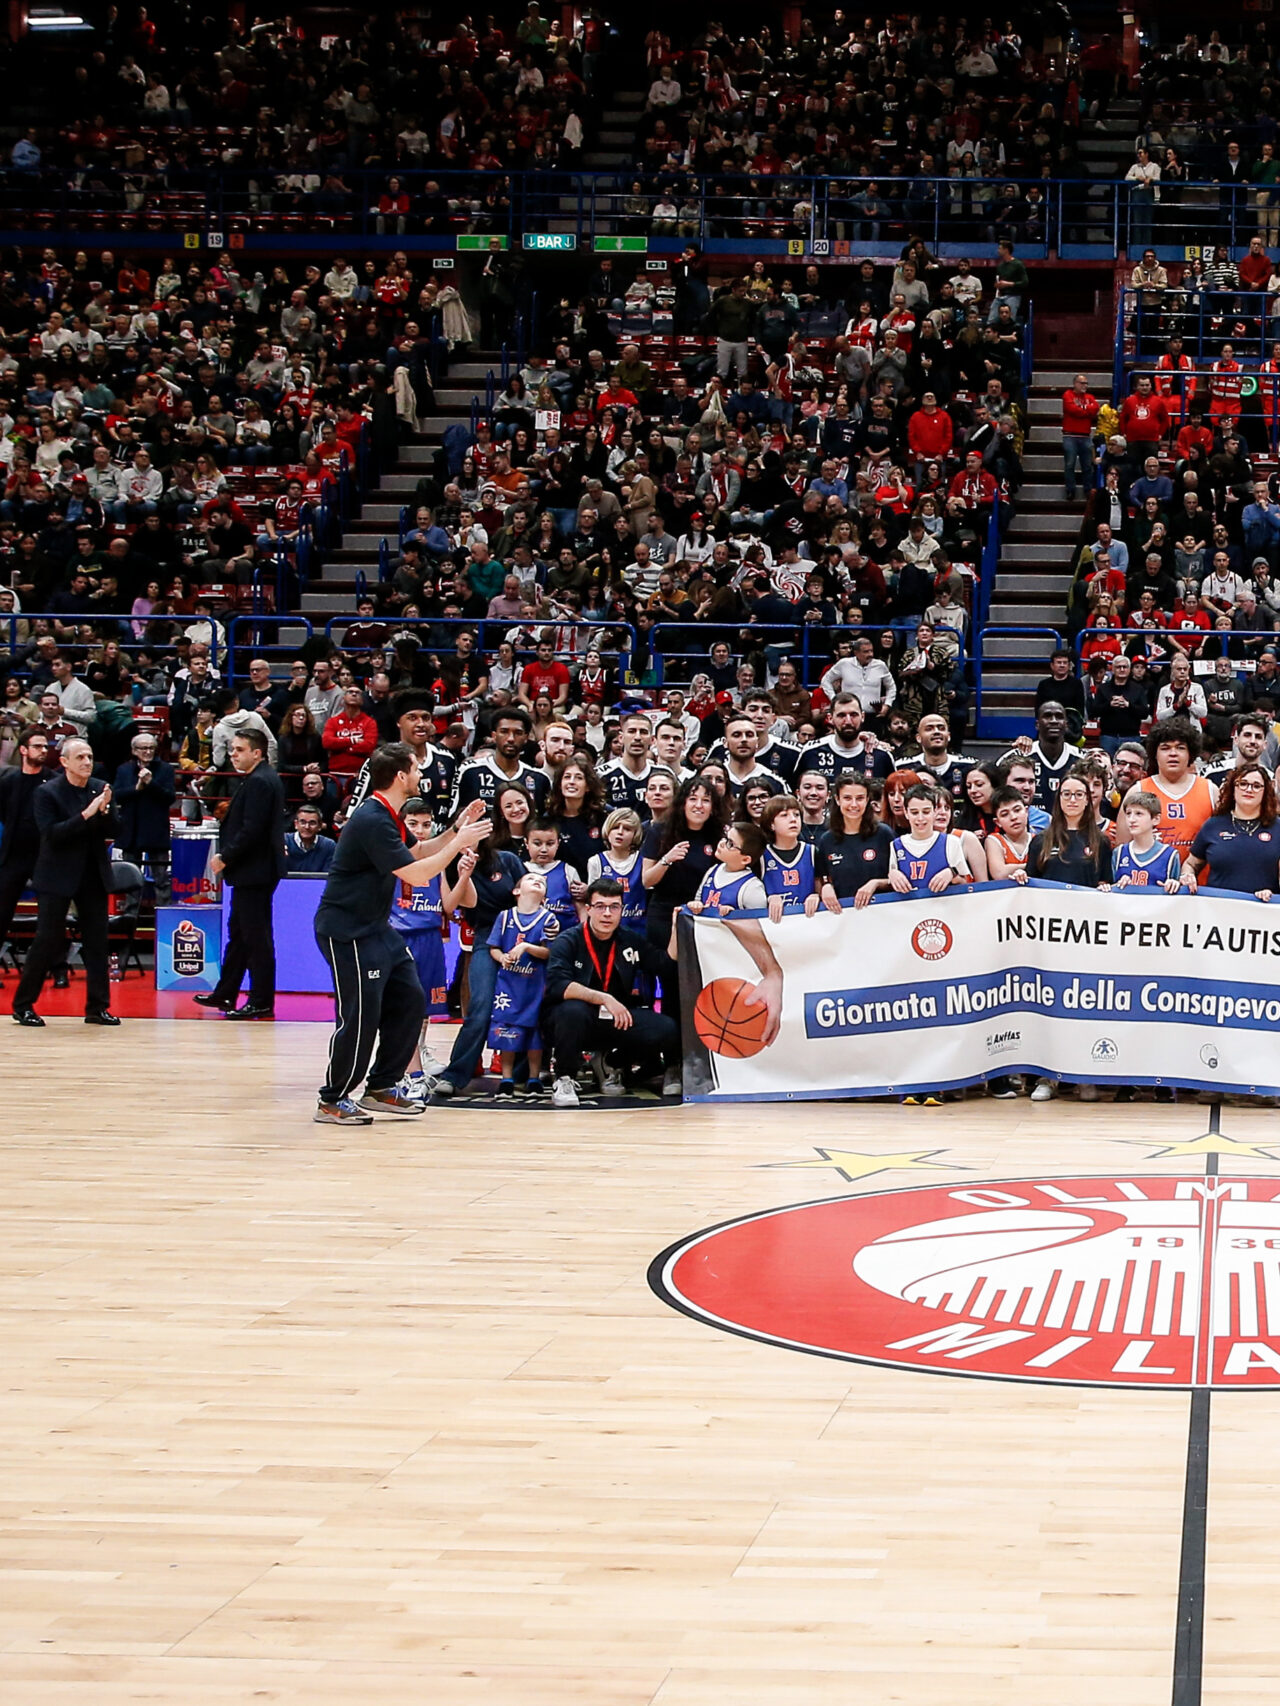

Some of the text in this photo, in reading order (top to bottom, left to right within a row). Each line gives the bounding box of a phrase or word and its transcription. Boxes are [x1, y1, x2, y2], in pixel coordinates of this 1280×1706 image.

[210, 235, 222, 245] 19
[536, 236, 561, 249] BAR
[815, 241, 828, 251] 20
[818, 752, 835, 767] 33
[478, 772, 495, 787] 12
[610, 774, 626, 791] 21
[479, 789, 496, 798] EA7
[612, 793, 629, 801] EA7
[1167, 803, 1185, 819] 51
[909, 861, 928, 880] 17
[782, 869, 800, 886] 13
[1131, 869, 1149, 886] 18
[705, 889, 722, 907] 14
[917, 920, 943, 931] OLIMPIA
[996, 915, 1109, 945] INSIEME
[1120, 922, 1170, 948] PER
[465, 928, 476, 937] EA
[177, 942, 201, 954] LBA
[922, 950, 947, 960] MILANO
[179, 961, 200, 972] Unipol
[367, 969, 381, 980] EA7
[430, 986, 448, 1005] 15
[815, 992, 937, 1029] Giornata
[945, 973, 1055, 1016] Mondiale
[1062, 977, 1131, 1011] della
[1125, 1236, 1184, 1248] 19
